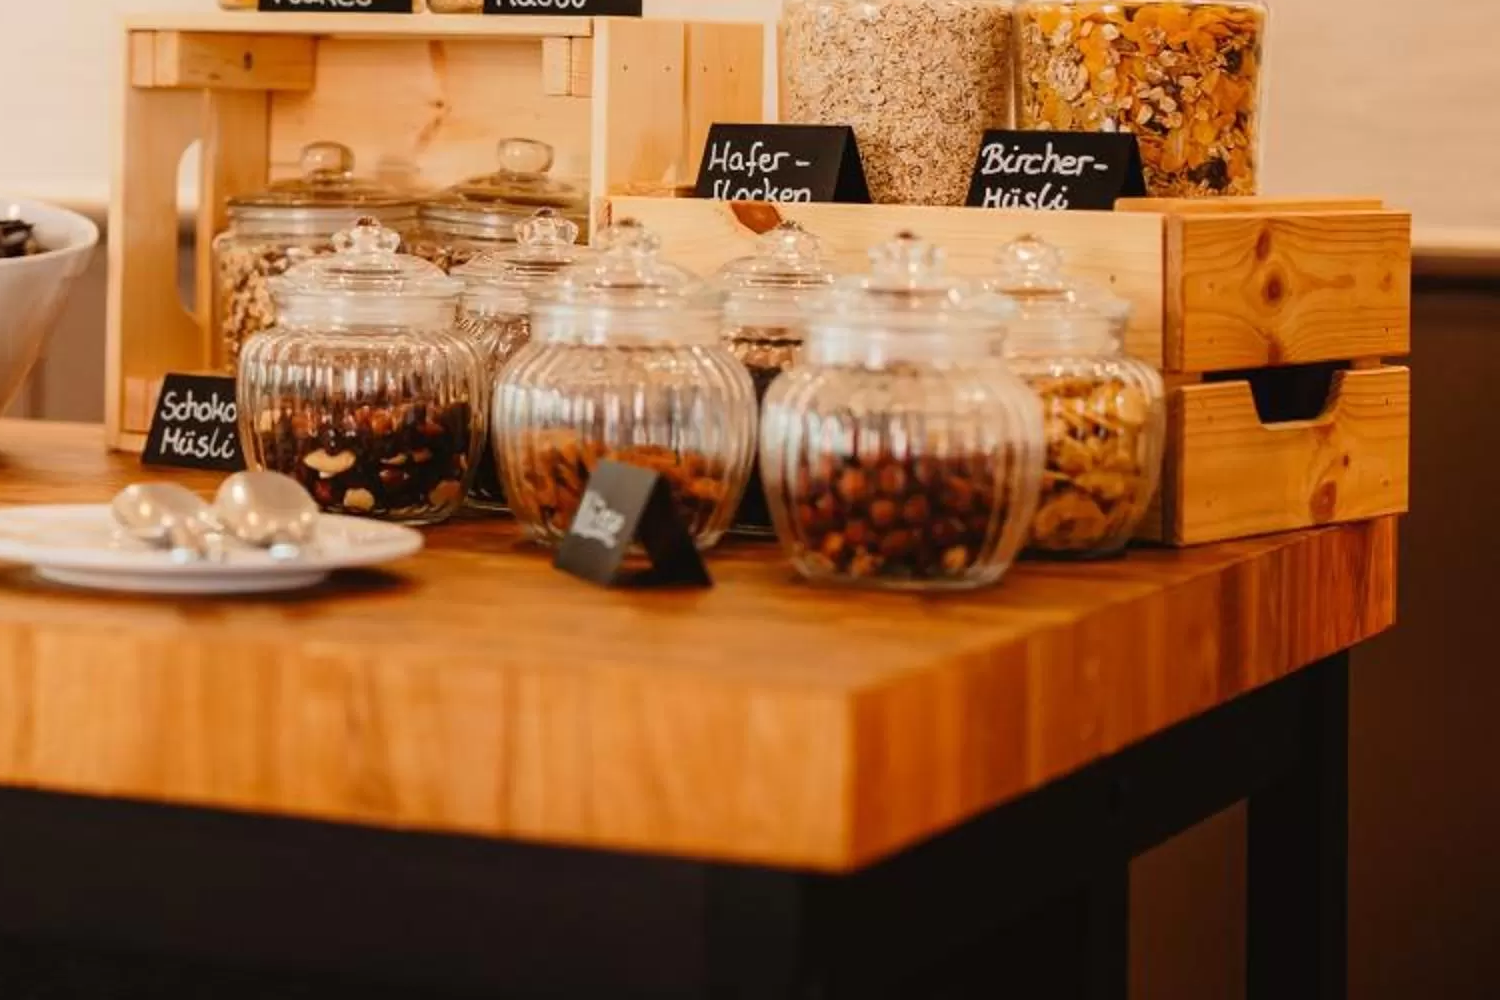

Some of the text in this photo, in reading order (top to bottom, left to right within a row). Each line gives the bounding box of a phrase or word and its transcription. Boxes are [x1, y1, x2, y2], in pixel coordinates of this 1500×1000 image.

[981, 141, 1108, 176] Bircher-
[161, 389, 237, 423] Schoko
[160, 427, 235, 458] Müsli
